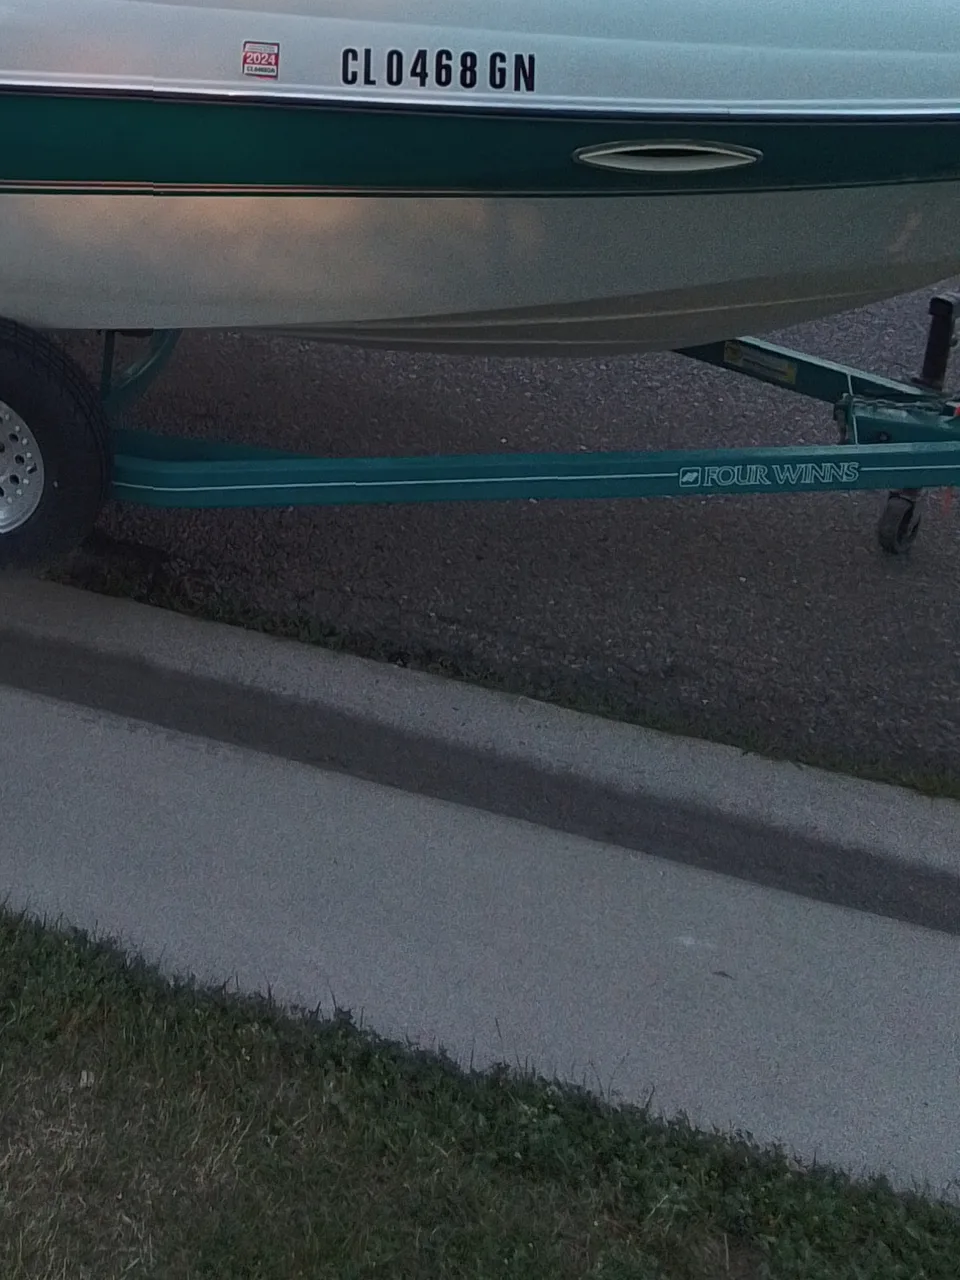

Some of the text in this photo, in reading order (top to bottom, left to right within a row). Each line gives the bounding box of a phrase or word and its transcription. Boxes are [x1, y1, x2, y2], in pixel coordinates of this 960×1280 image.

[246, 52, 276, 65] 2024
[703, 462, 859, 486] FOUR WINNS
